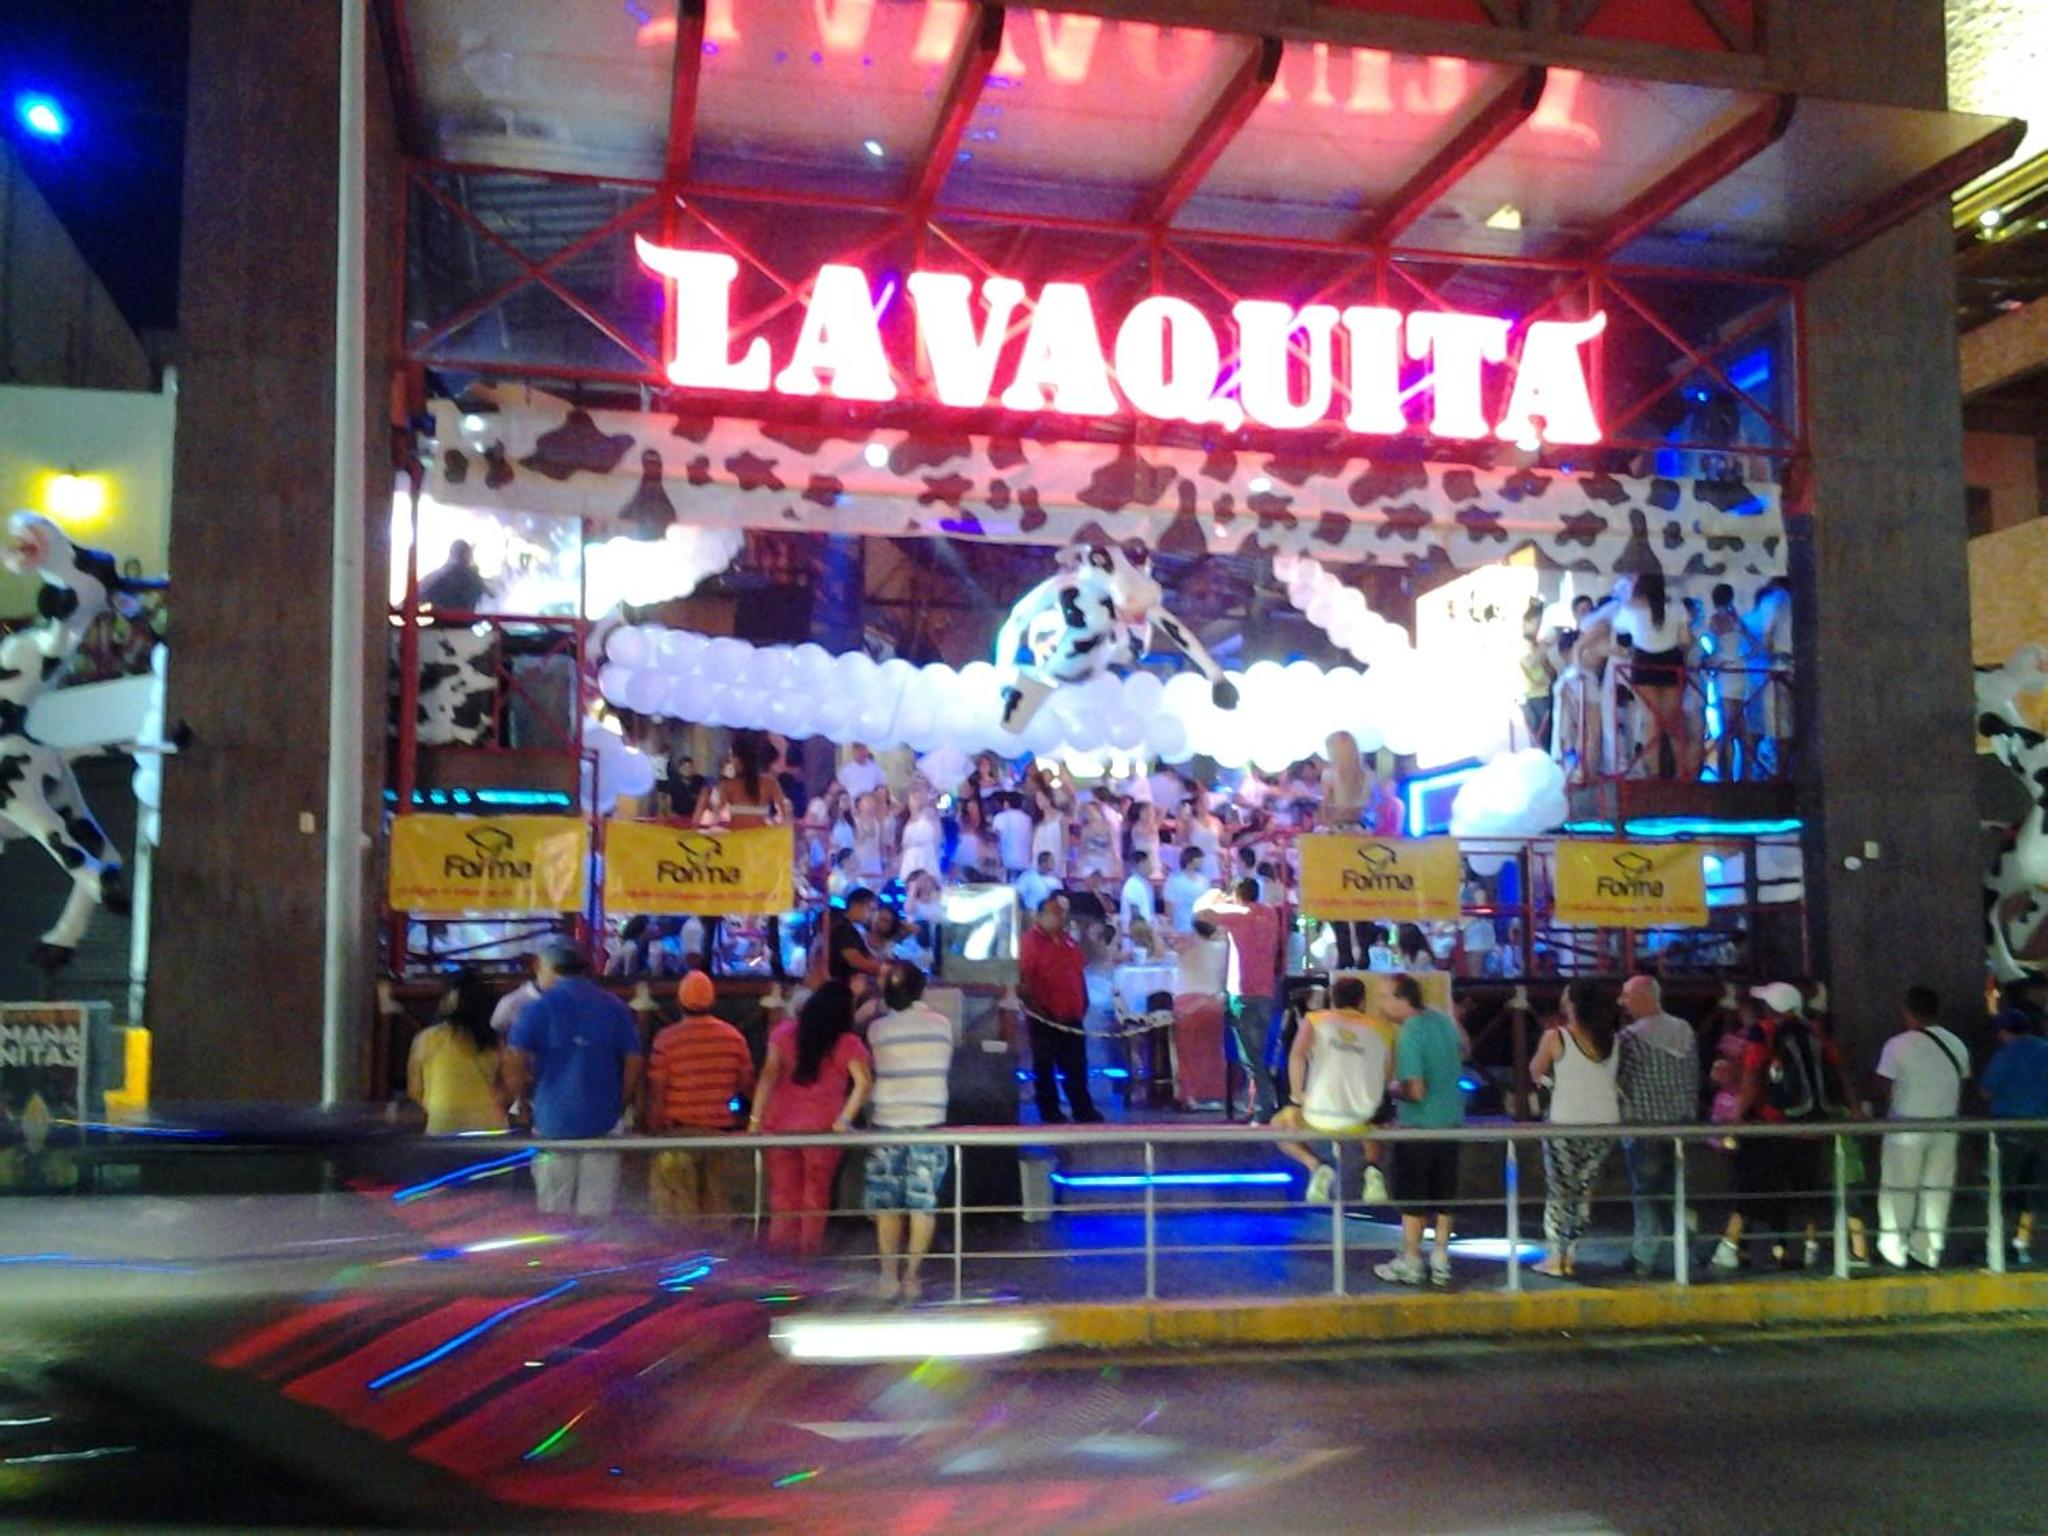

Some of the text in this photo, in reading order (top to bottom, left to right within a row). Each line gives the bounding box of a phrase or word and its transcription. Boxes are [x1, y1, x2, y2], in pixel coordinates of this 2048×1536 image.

[444, 853, 532, 879] Forma
[657, 860, 741, 884] Forma
[1342, 869, 1414, 892] Forma
[1597, 876, 1664, 898] Forma
